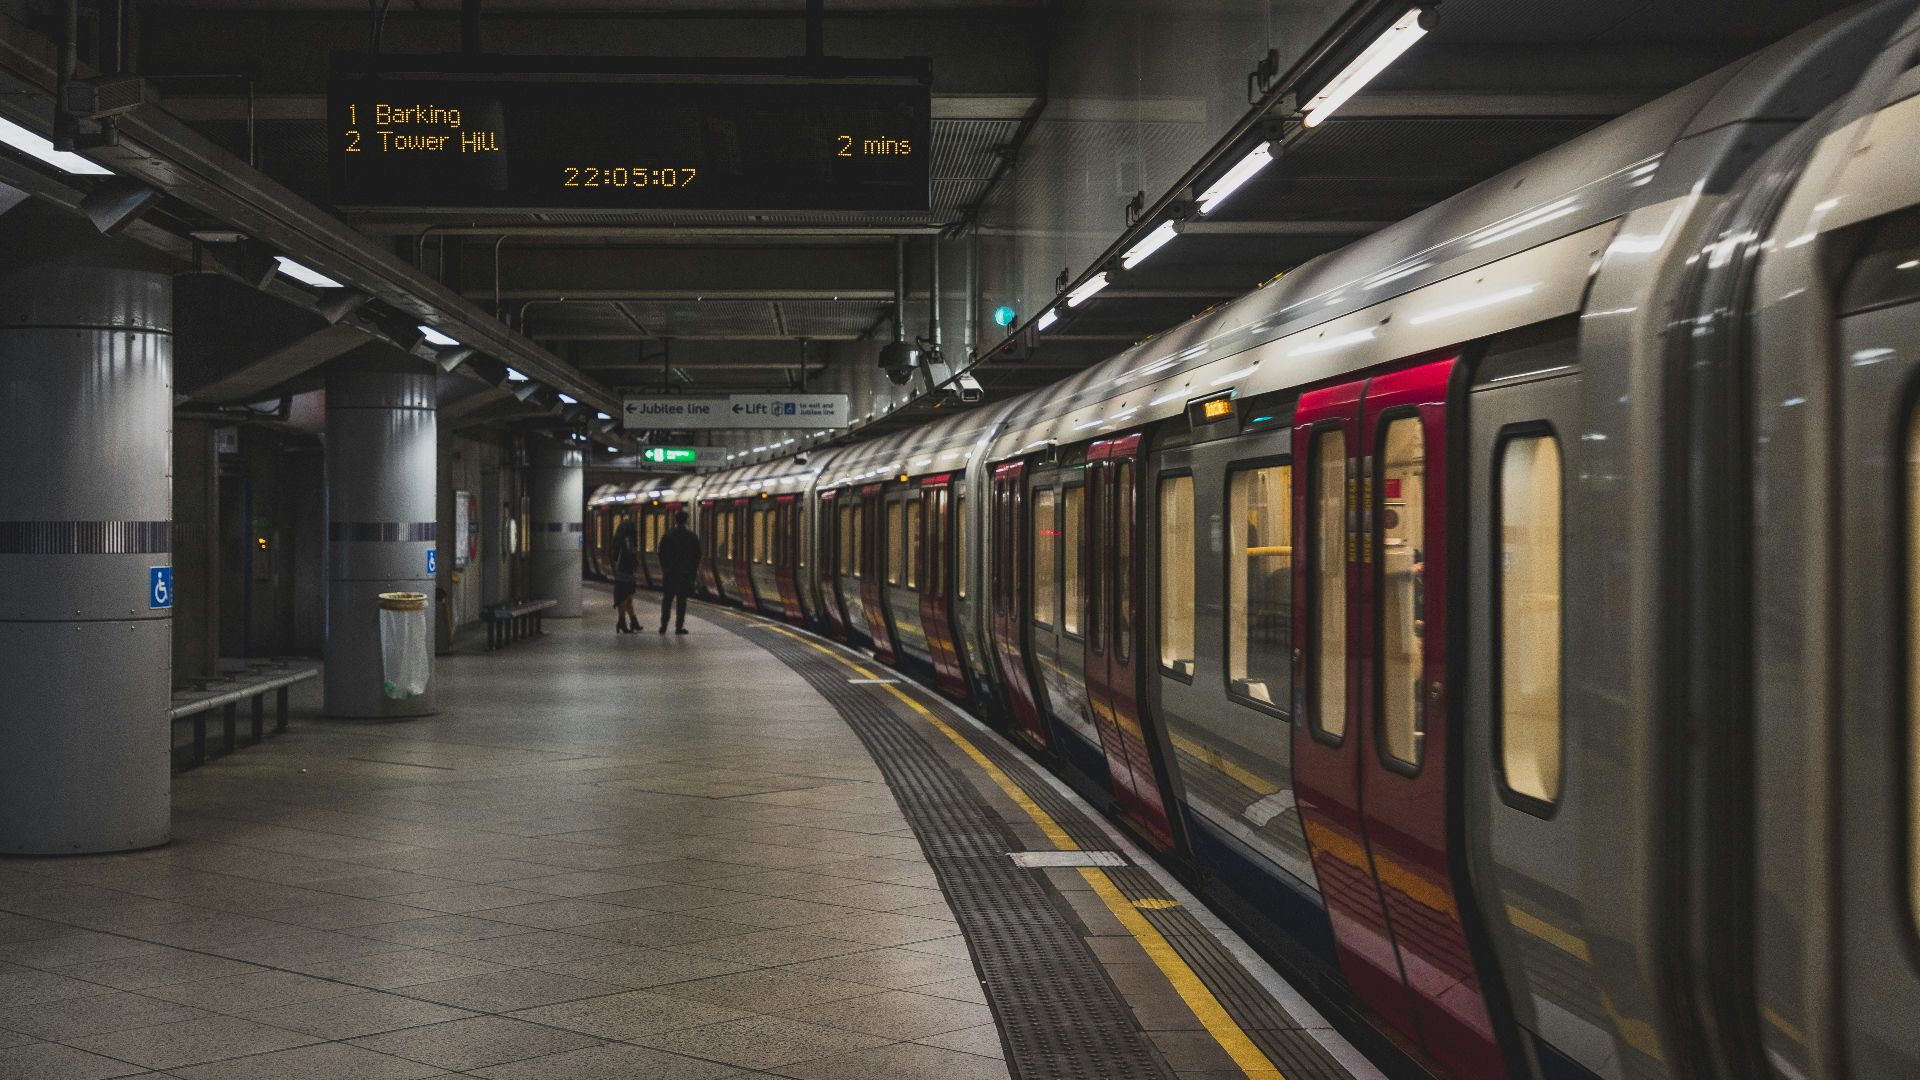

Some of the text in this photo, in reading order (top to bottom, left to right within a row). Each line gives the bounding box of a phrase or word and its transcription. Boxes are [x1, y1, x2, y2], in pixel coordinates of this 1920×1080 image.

[349, 104, 461, 128] 1 Barking
[346, 130, 911, 156] 2 Tower Hill 2 mins
[564, 167, 696, 187] 22:05:07
[640, 403, 710, 414] Jubilee line
[746, 403, 768, 415] Lift
